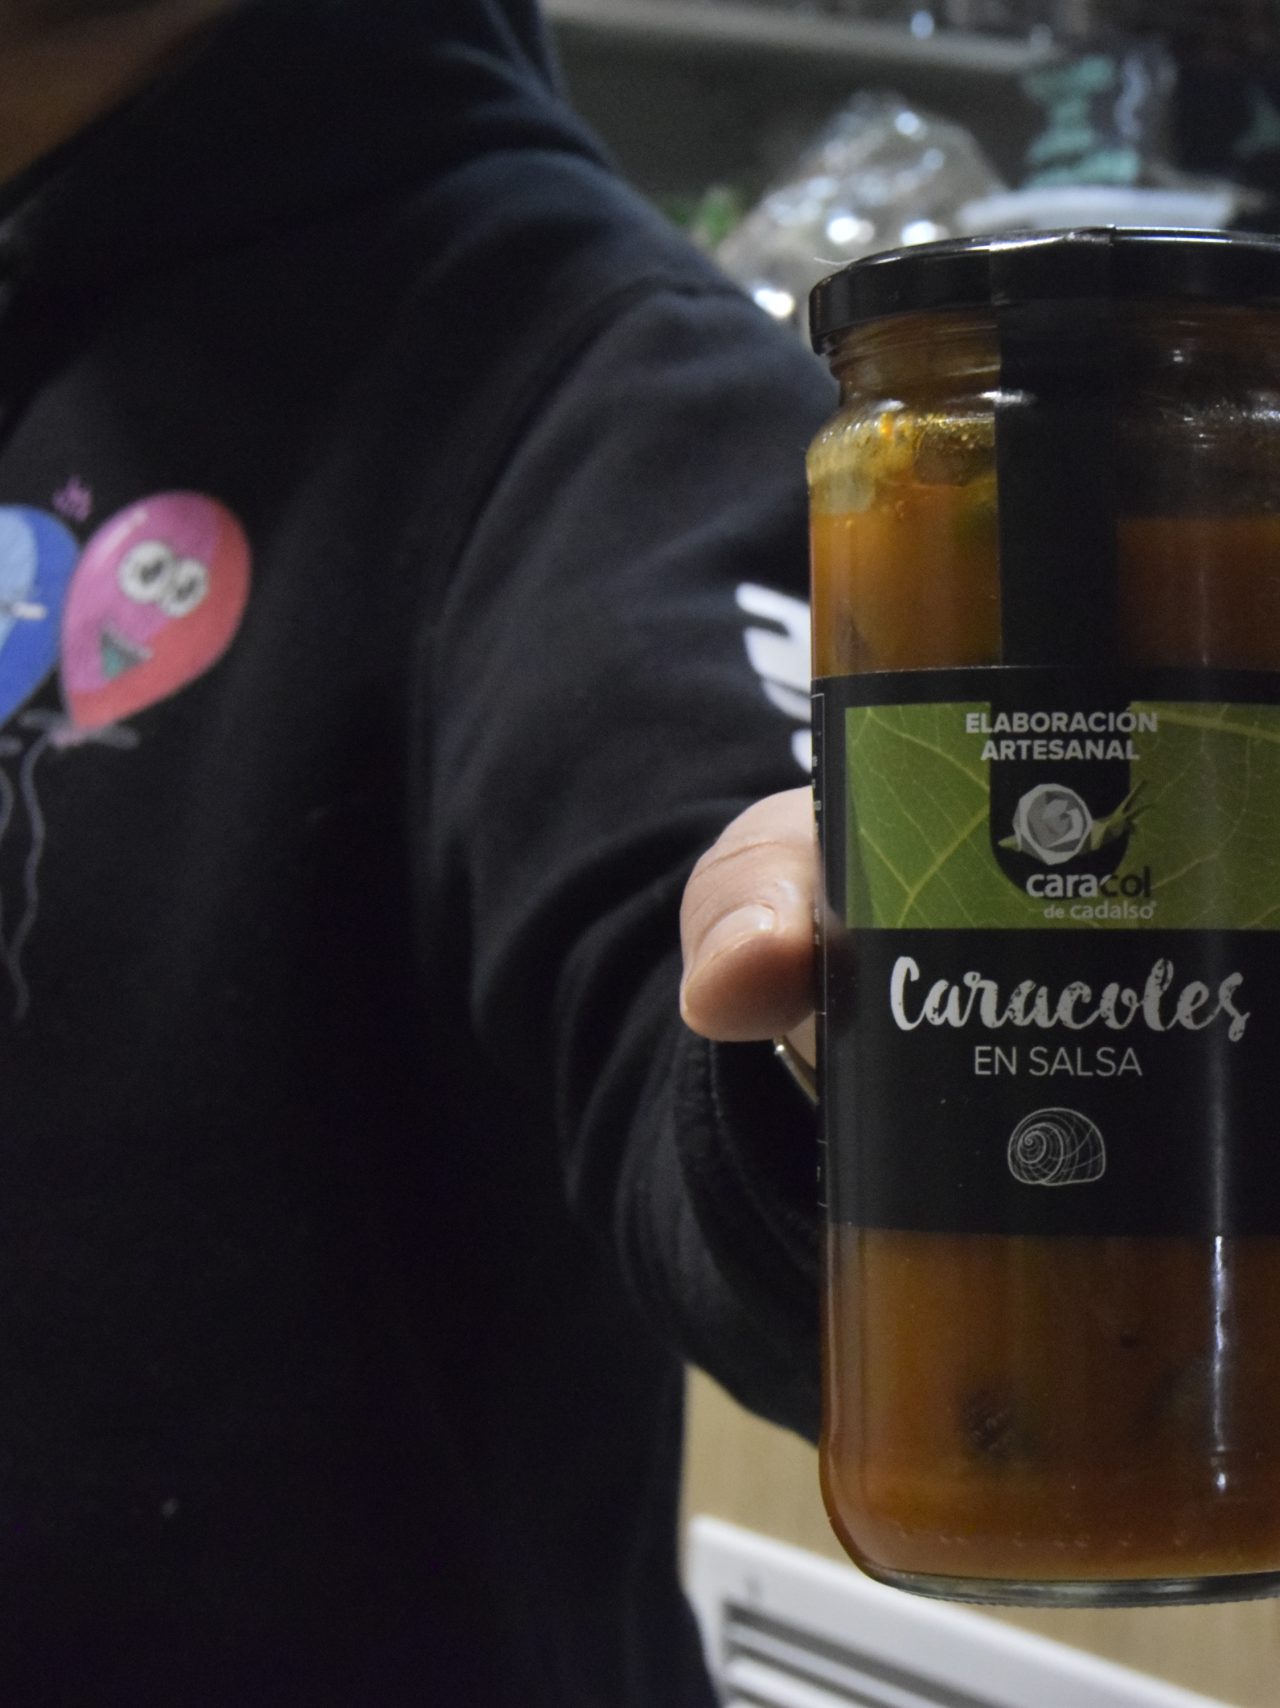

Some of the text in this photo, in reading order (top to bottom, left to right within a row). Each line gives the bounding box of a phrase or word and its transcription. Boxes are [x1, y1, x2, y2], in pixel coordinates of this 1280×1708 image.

[965, 708, 1158, 734] ELABORACIÓN
[980, 738, 1141, 761] ARTESANAL
[1026, 865, 1152, 898] caracol
[1043, 900, 1154, 920] de cadalso
[890, 956, 1251, 1042] Caracoles
[974, 1046, 1143, 1077] EN SALSA
